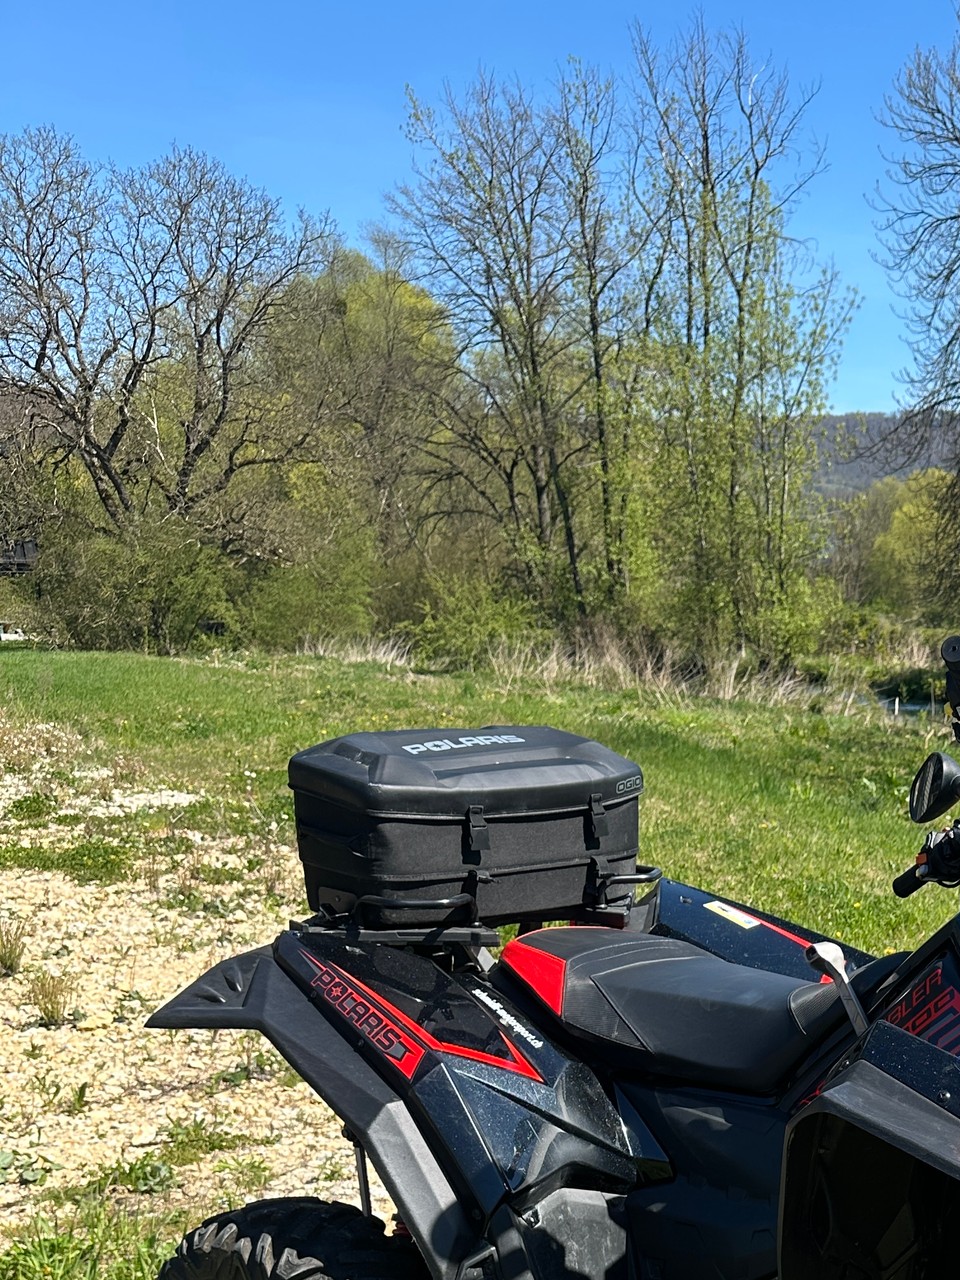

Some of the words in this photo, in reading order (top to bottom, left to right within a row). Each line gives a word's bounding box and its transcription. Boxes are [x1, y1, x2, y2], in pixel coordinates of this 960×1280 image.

[401, 735, 526, 754] POLARIS
[616, 775, 642, 794] OGIO
[310, 968, 402, 1052] POLARIS
